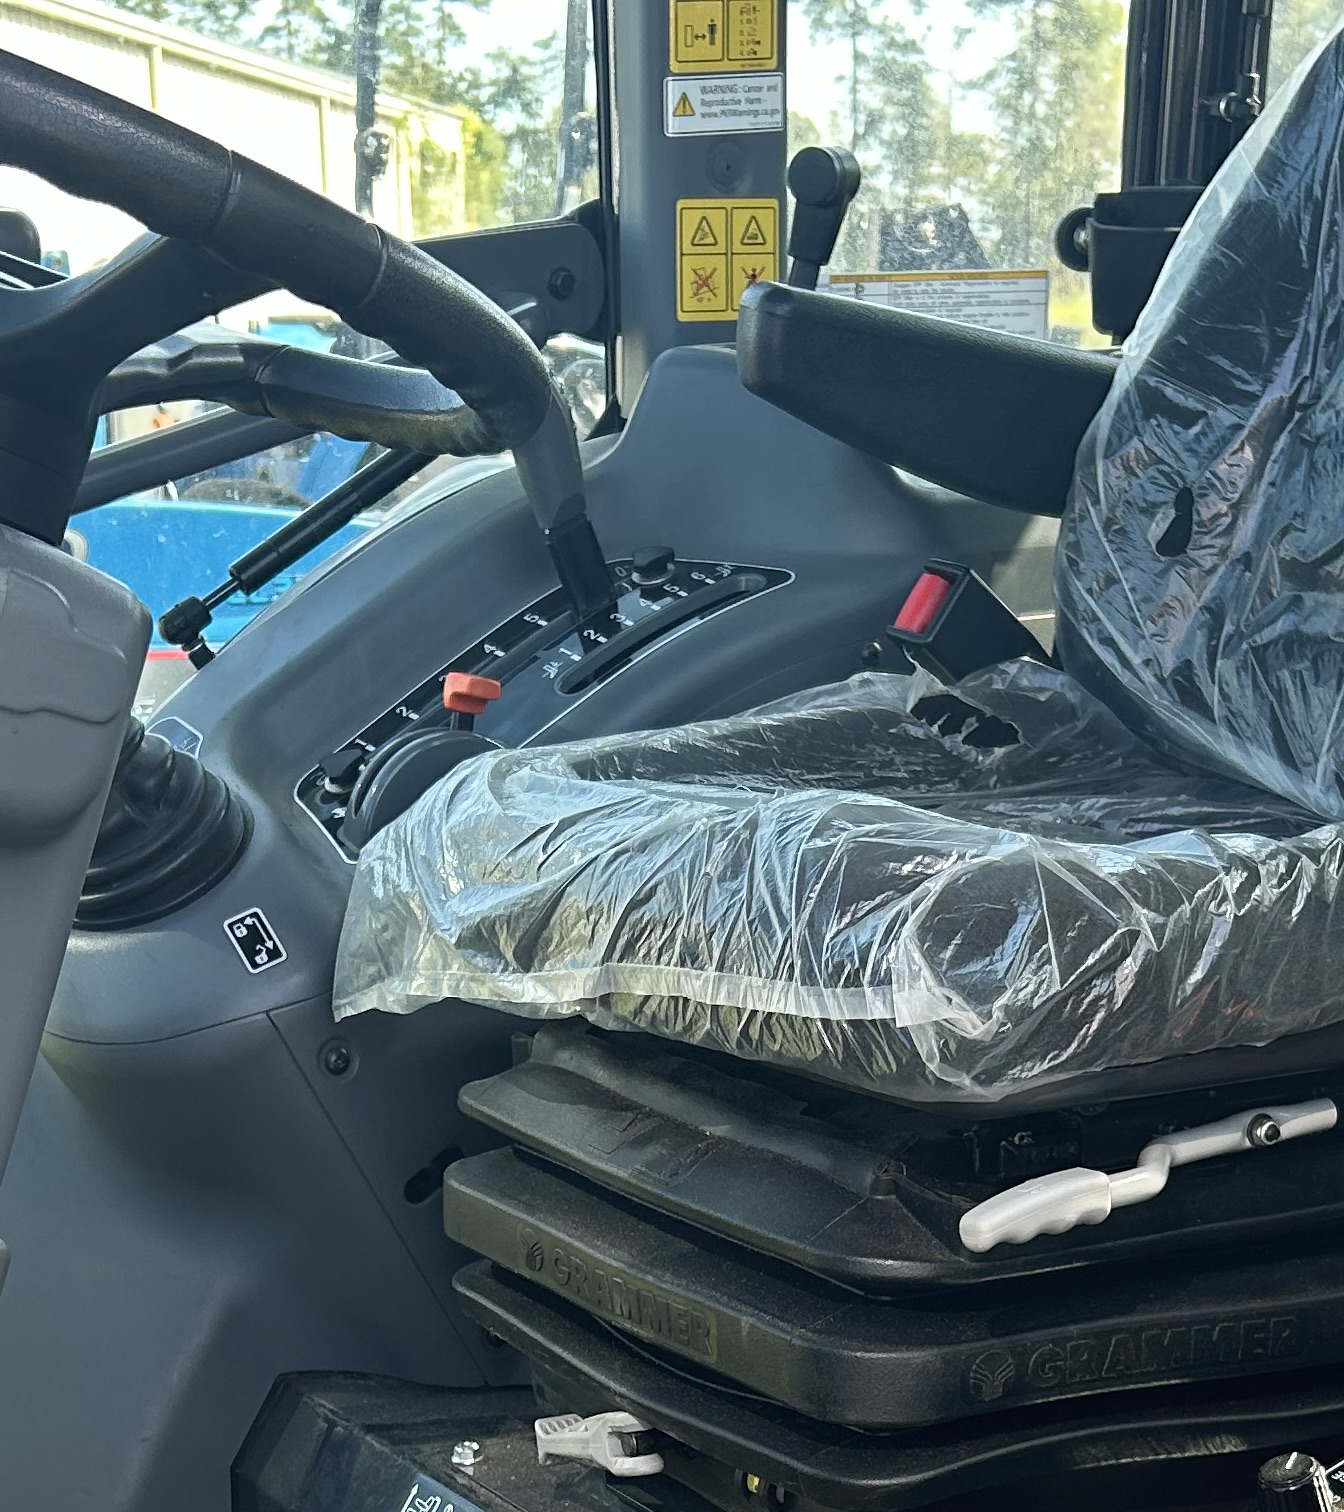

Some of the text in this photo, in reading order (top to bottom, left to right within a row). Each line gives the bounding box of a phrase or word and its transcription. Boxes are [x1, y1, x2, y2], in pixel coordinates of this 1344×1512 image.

[583, 629, 601, 640] 2
[609, 613, 626, 622] 3
[662, 583, 680, 593] 5
[690, 571, 706, 580] 6
[396, 706, 413, 717] 2
[523, 613, 540, 623] 5
[554, 1247, 714, 1356] GRAMMER
[1027, 1315, 1298, 1388] GRAMMER
